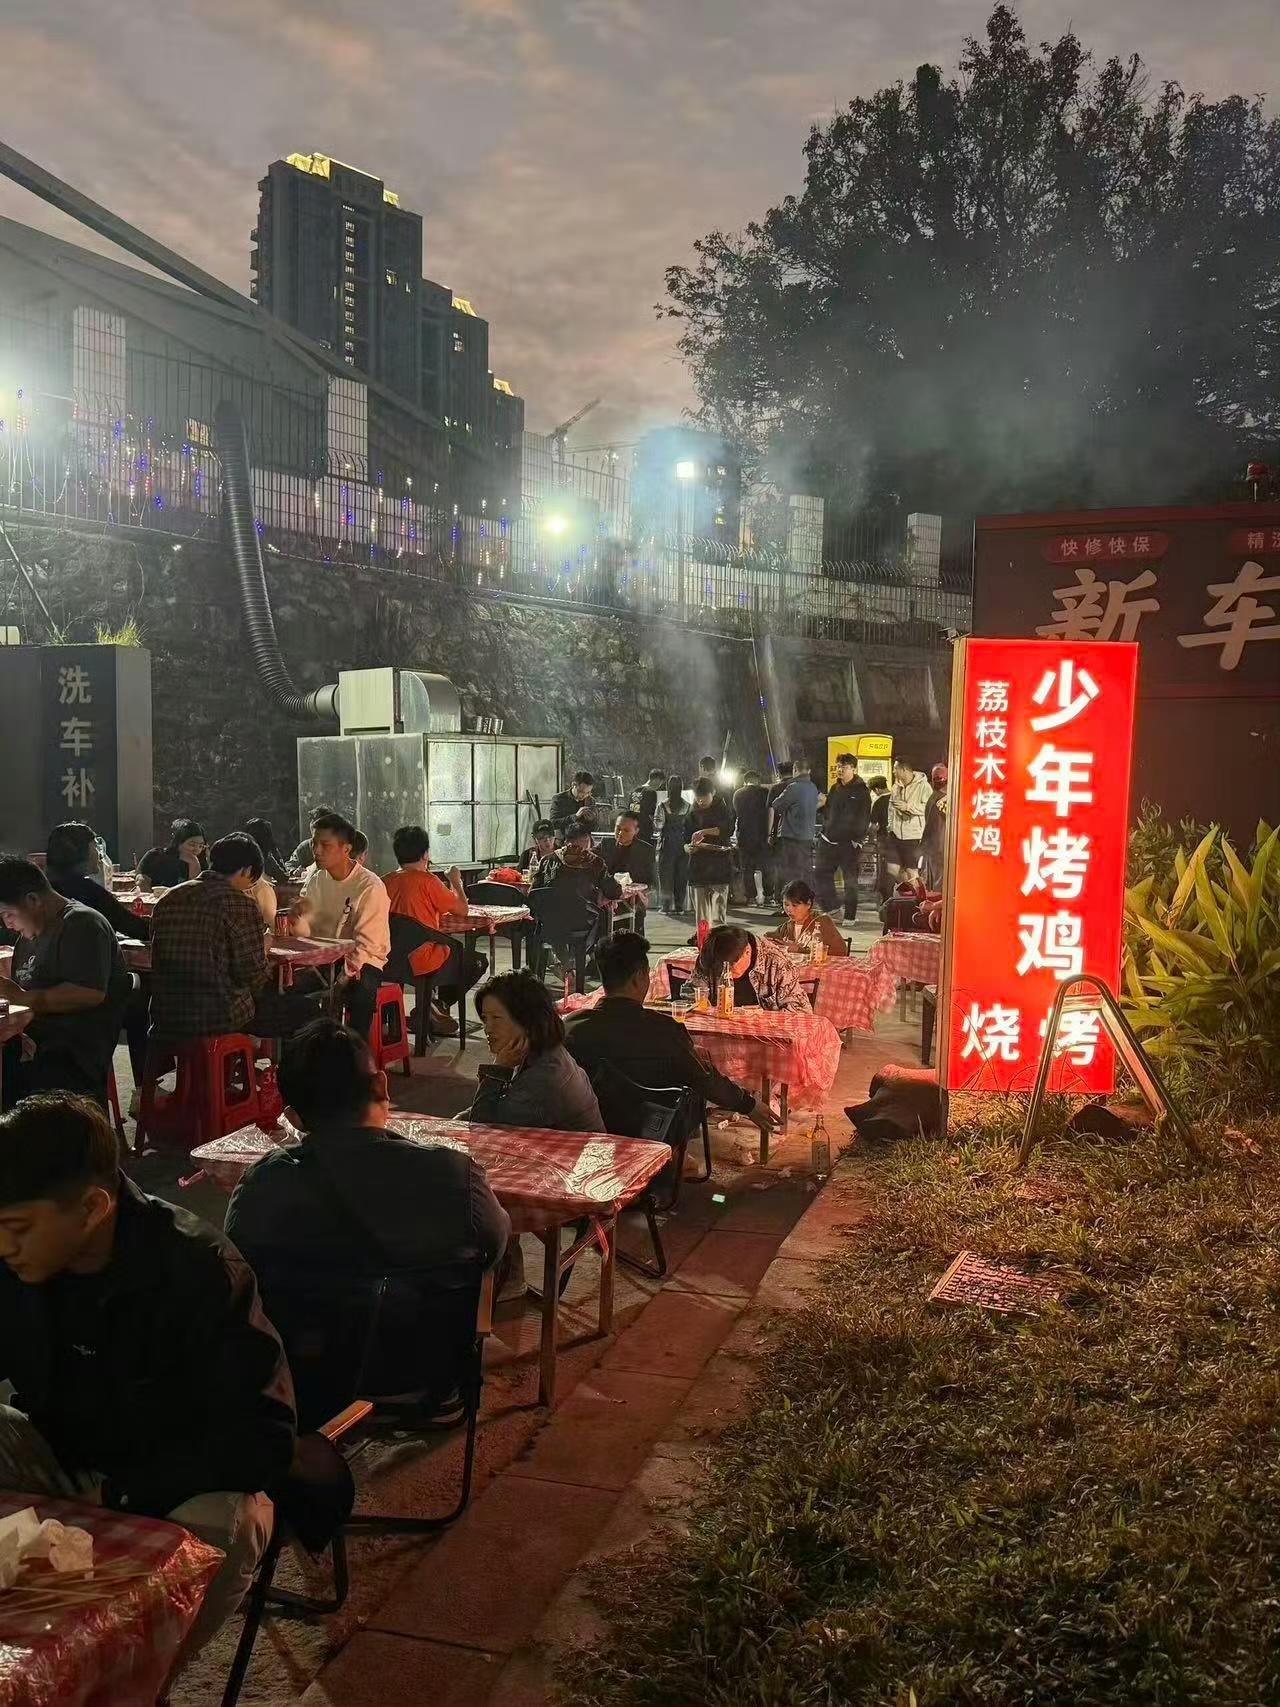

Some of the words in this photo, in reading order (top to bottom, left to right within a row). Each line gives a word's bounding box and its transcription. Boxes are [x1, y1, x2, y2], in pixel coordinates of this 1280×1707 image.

[1061, 536, 1150, 556] 快修快保
[1036, 562, 1280, 671] 新车
[971, 680, 1009, 857] 荔枝木烤鸡
[1015, 660, 1100, 981] 少年烤鸡
[960, 1003, 1100, 1066] 烧烤
